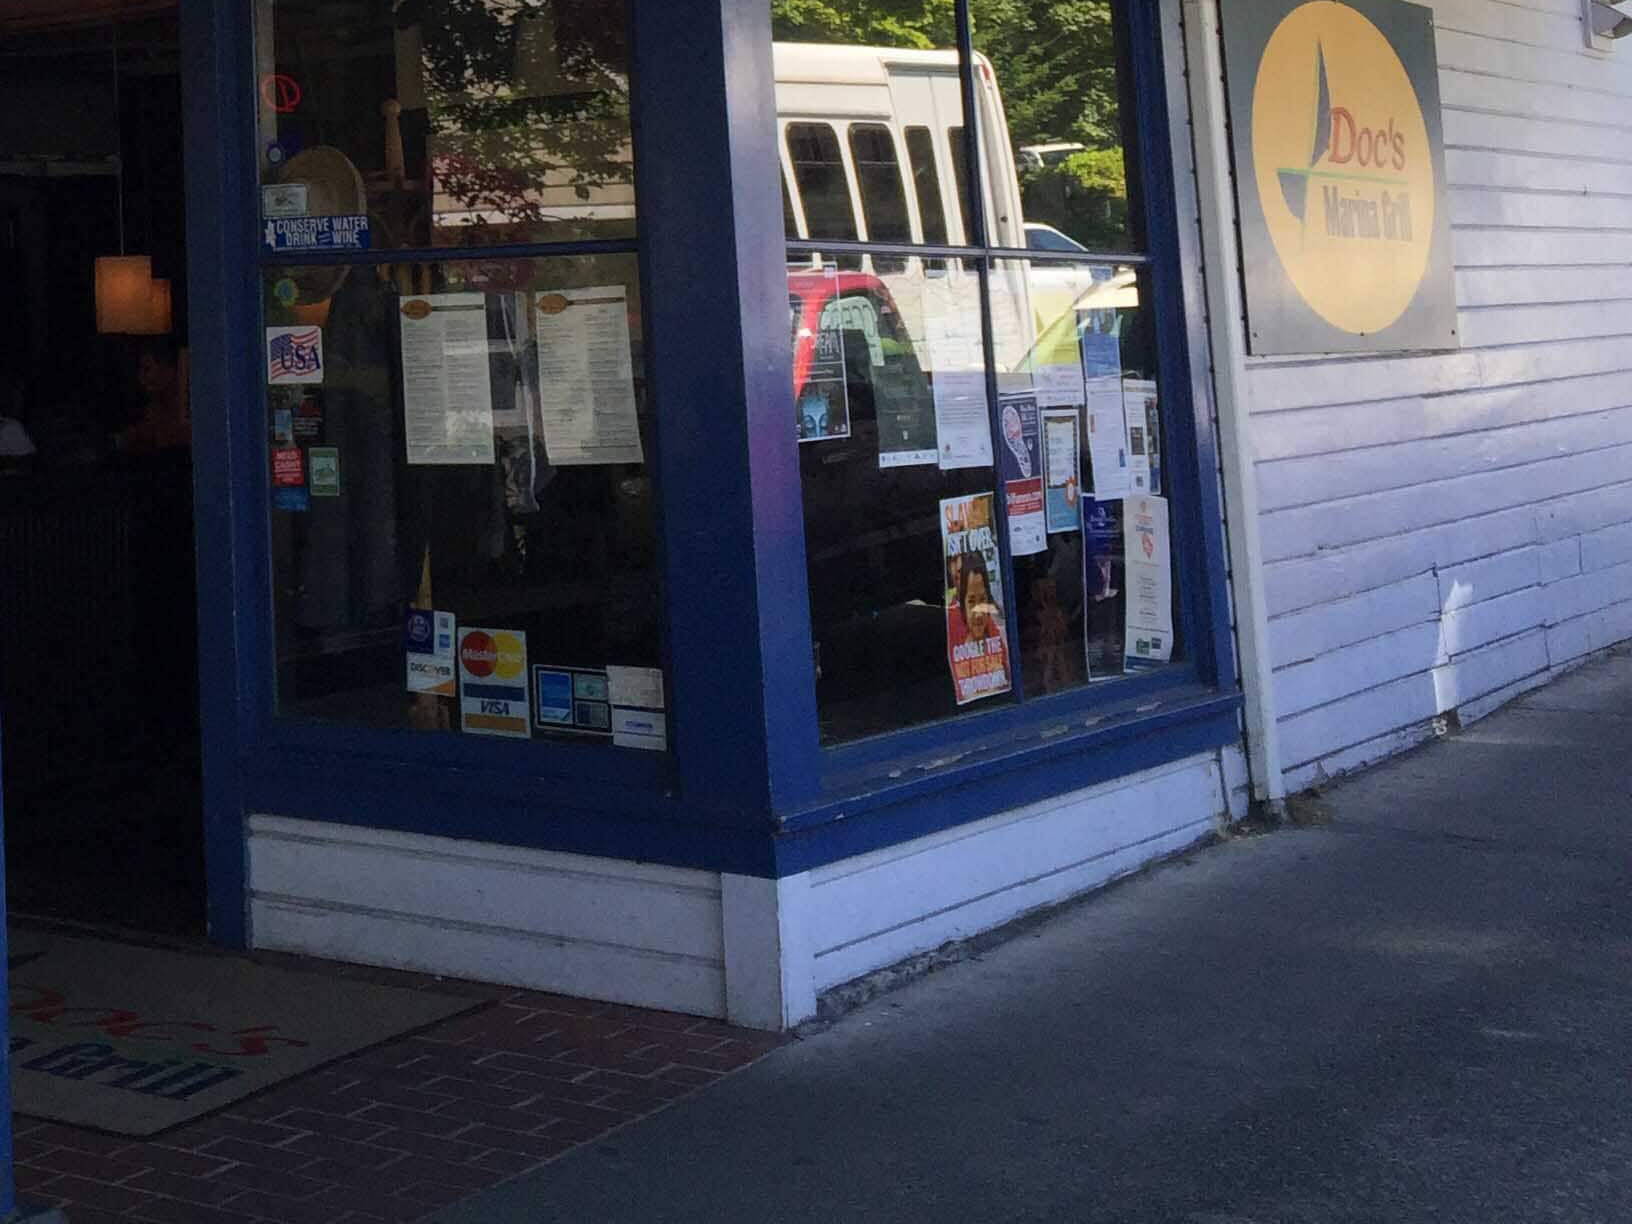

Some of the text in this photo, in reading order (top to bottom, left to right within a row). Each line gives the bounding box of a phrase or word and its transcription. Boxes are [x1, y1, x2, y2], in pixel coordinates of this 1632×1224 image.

[1328, 106, 1406, 171] Doc's
[276, 216, 369, 235] CONSERVE WATER
[1322, 185, 1413, 243] Marina Grill
[285, 229, 360, 246] DRINK WINE
[280, 344, 321, 371] USA
[480, 699, 511, 715] VISA
